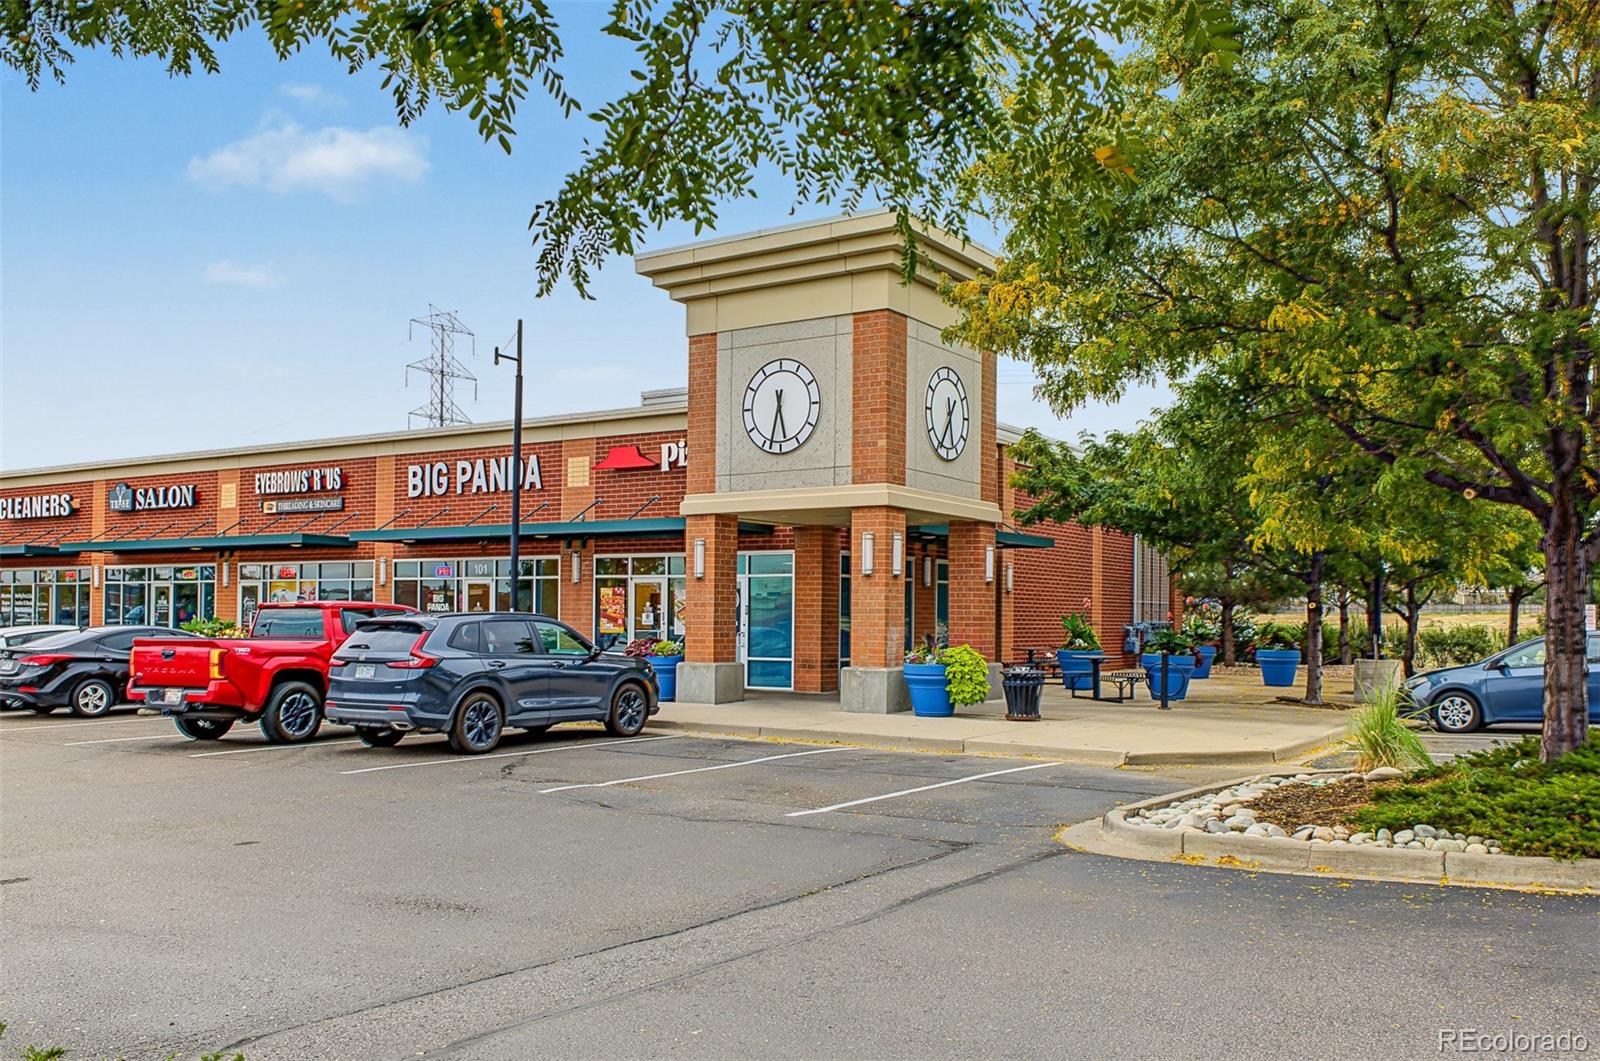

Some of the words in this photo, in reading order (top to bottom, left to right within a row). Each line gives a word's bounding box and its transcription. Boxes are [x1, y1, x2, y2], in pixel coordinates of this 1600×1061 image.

[660, 441, 688, 472] Pi
[255, 470, 309, 495] EYEBROWS
[408, 461, 449, 498] BIG
[456, 454, 542, 495] PANDA
[0, 493, 72, 520] CLEANERS
[136, 484, 194, 510] SALON
[474, 563, 488, 575] 101
[427, 603, 450, 612] PANDA
[433, 594, 445, 603] BIG
